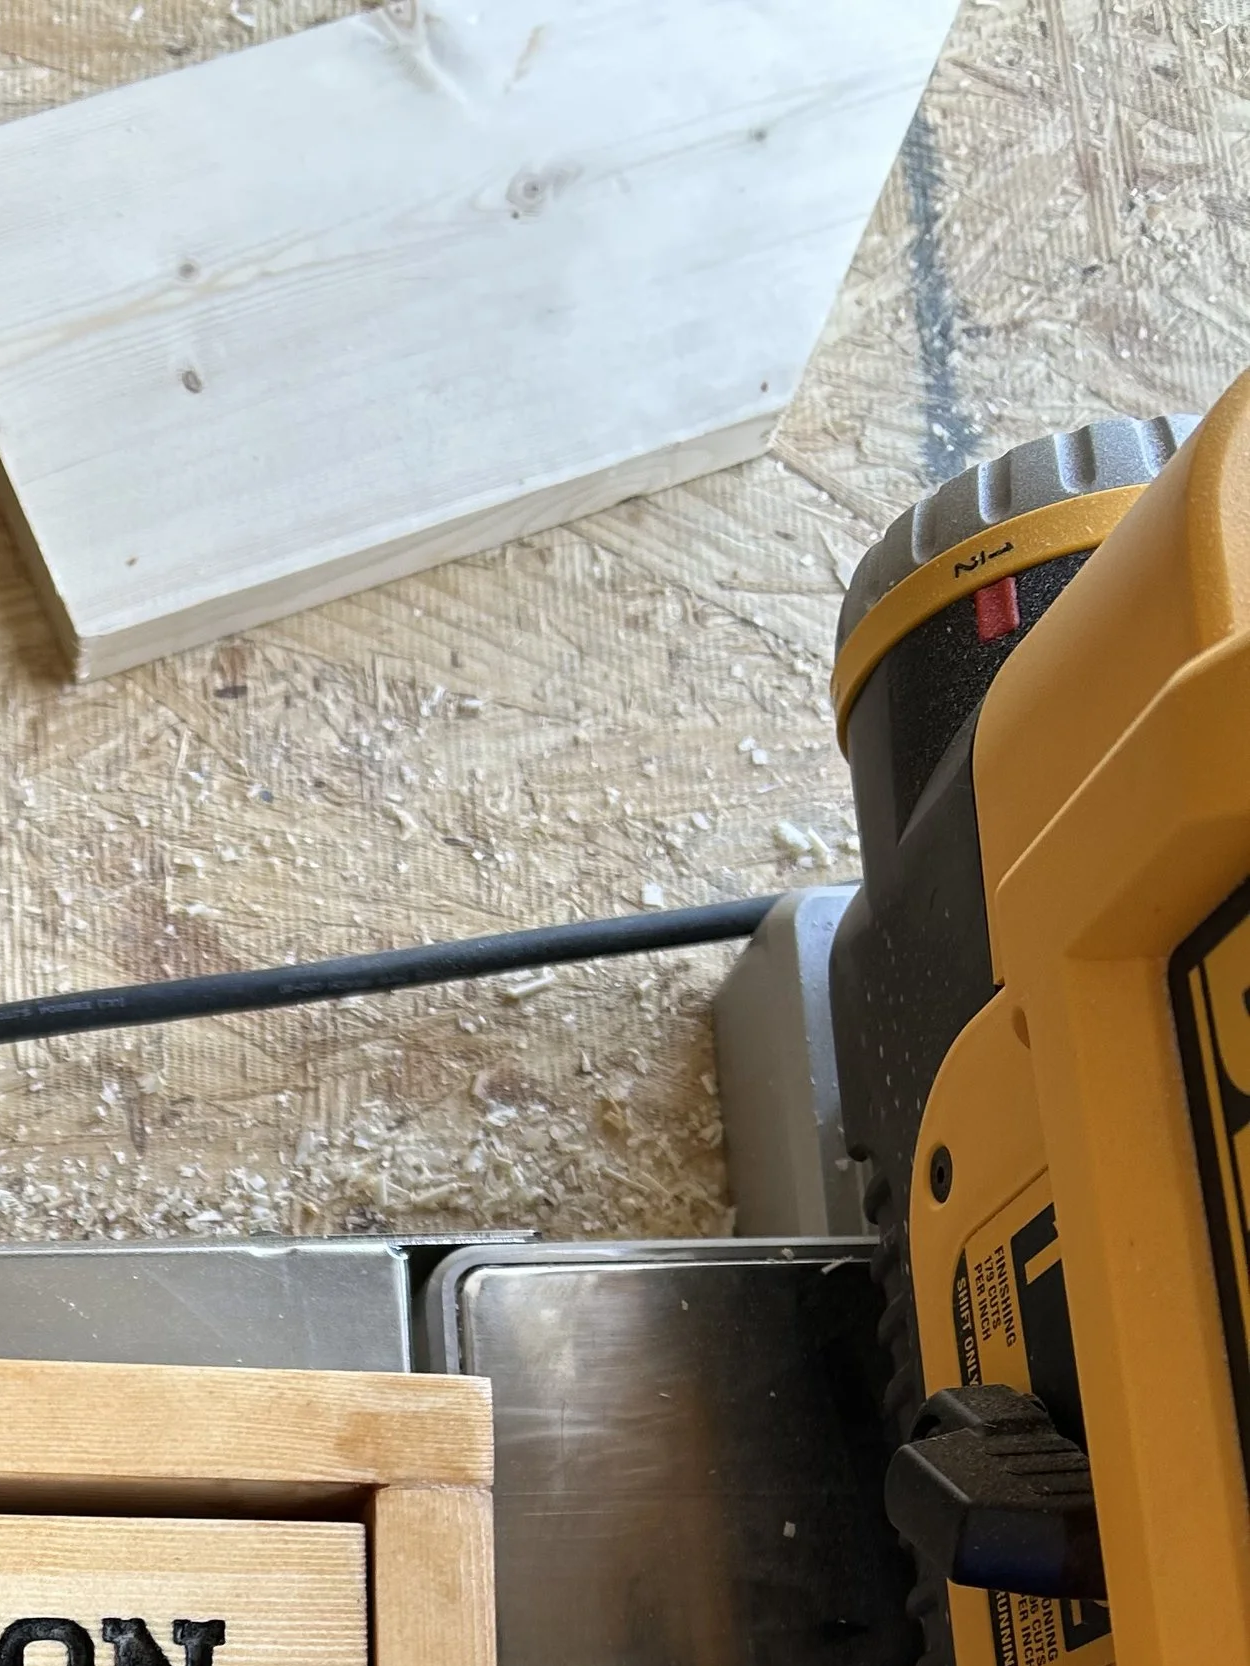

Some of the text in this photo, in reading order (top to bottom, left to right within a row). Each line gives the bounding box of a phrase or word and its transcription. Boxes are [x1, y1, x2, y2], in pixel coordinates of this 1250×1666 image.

[956, 1276, 981, 1387] SHIFT ONLY
[974, 1263, 992, 1341] PER INCH
[983, 1255, 1002, 1331] 179 CUTS
[994, 1245, 1017, 1347] FINISHING
[1032, 1618, 1047, 1666] CUTS
